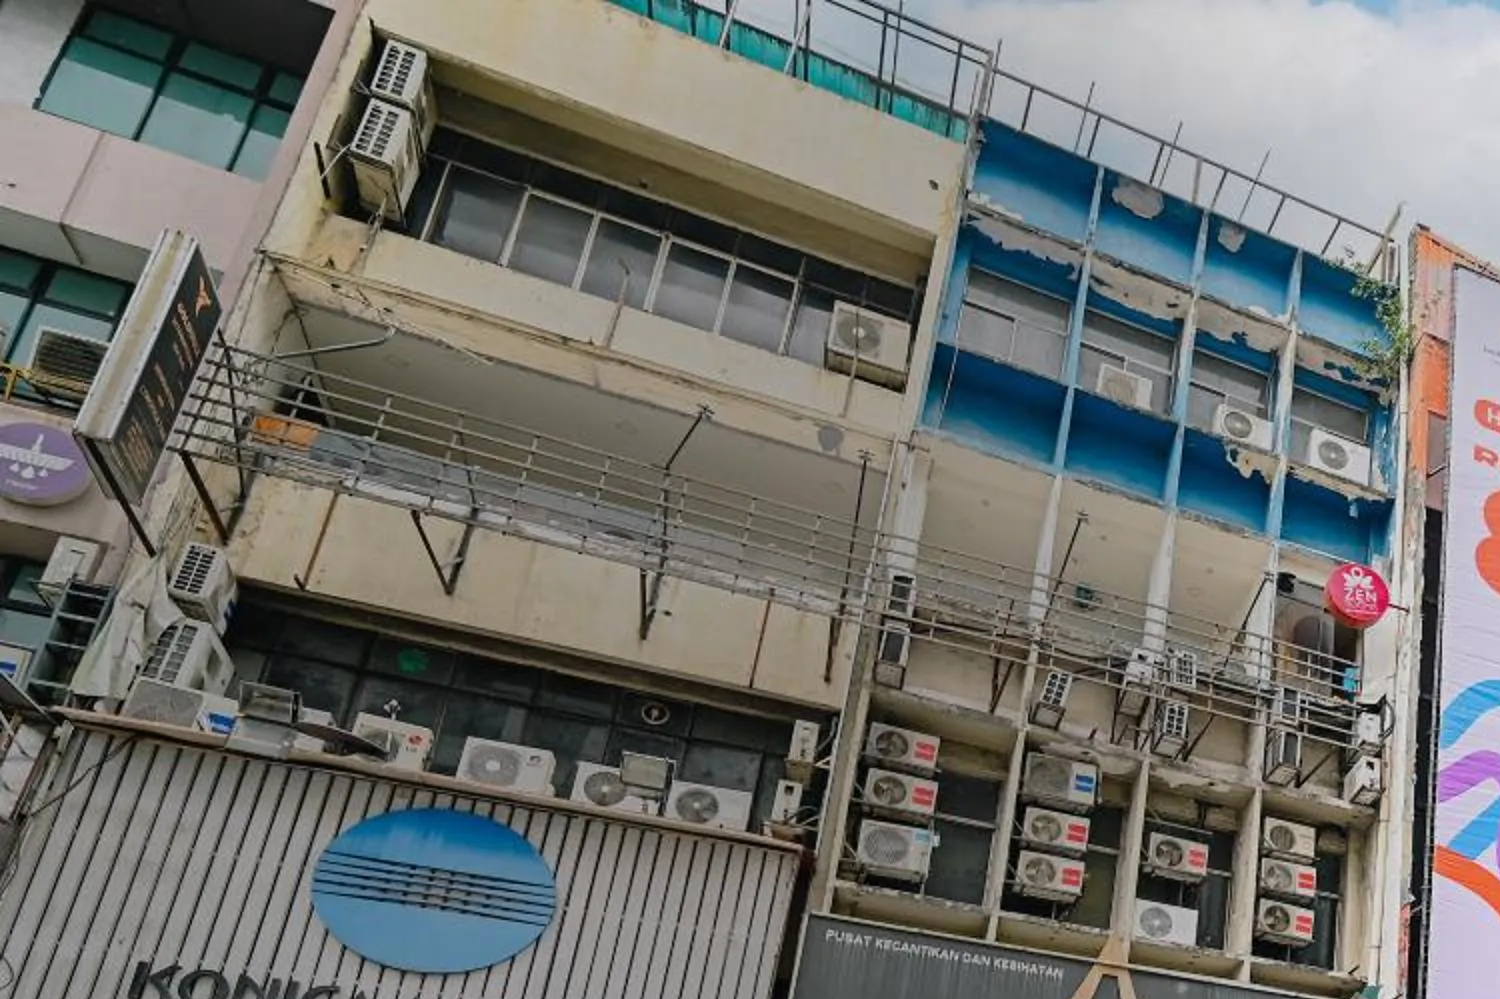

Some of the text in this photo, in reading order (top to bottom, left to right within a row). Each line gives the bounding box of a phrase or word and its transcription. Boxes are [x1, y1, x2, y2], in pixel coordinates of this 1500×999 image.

[1344, 588, 1377, 603] ZEN
[825, 928, 1065, 979] PUSAT KECANTIKAN DAN KESIHATAN
